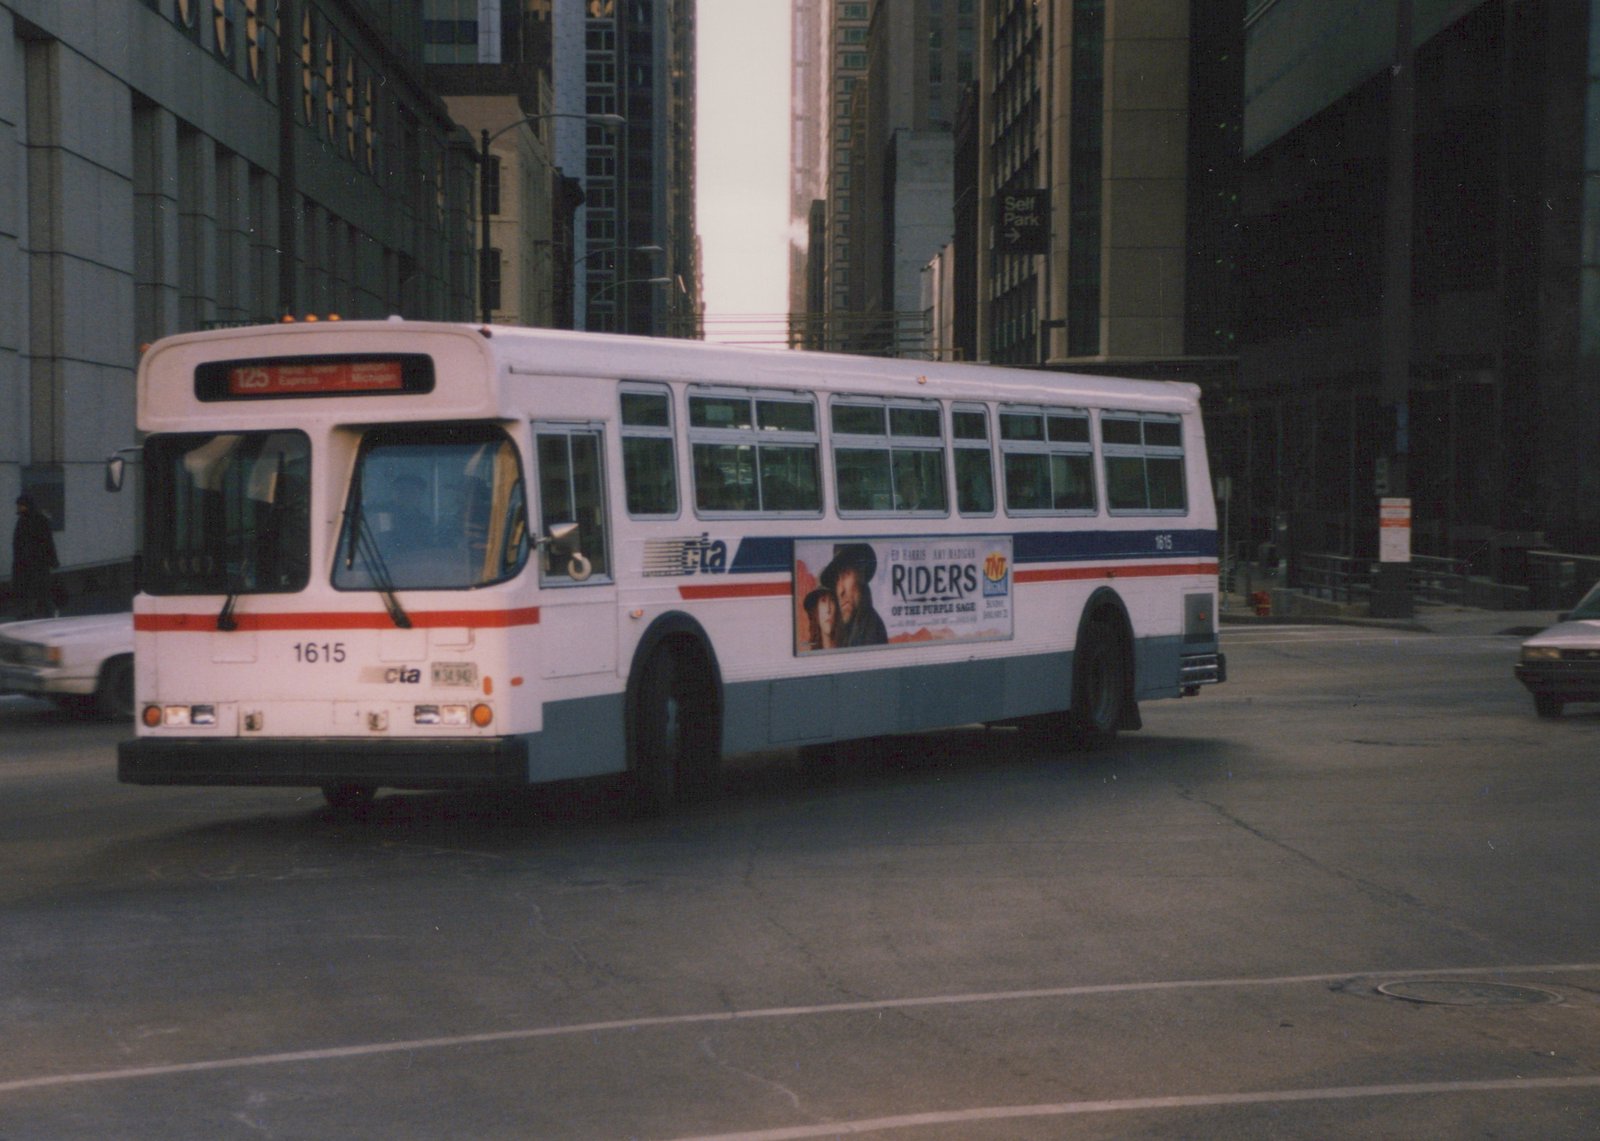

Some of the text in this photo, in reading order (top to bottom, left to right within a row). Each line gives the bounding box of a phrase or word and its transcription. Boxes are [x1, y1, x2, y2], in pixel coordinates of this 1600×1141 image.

[1004, 196, 1035, 211] Self
[1004, 213, 1040, 227] Park
[235, 367, 270, 389] 125
[681, 531, 727, 575] cta
[985, 556, 1007, 578] TNT
[891, 563, 977, 604] RIDERS
[891, 602, 977, 617] OF THE PURPLE SAGE
[293, 642, 347, 664] 1615
[383, 664, 421, 684] cta
